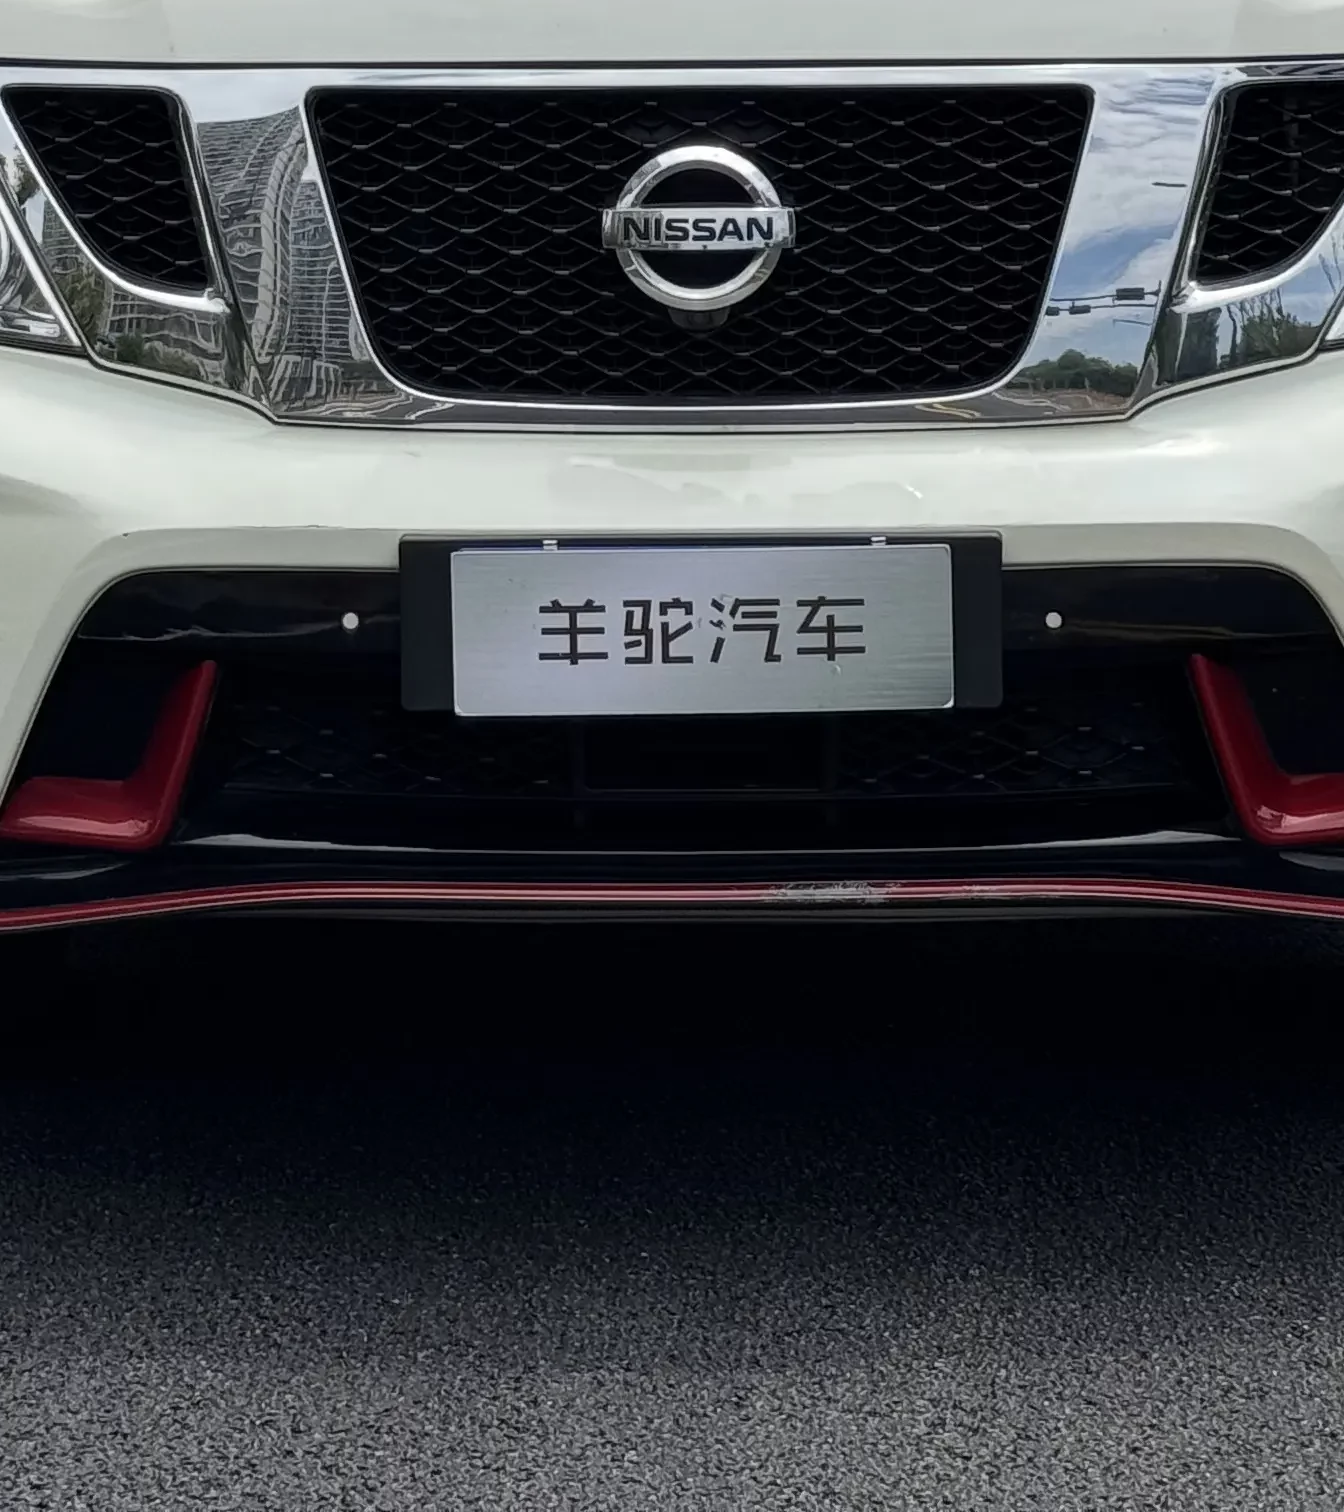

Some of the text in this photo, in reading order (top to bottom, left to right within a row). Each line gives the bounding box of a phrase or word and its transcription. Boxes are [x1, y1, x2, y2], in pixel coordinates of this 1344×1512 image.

[623, 216, 774, 242] NISSAN
[539, 596, 866, 666] 羊驼汽车
